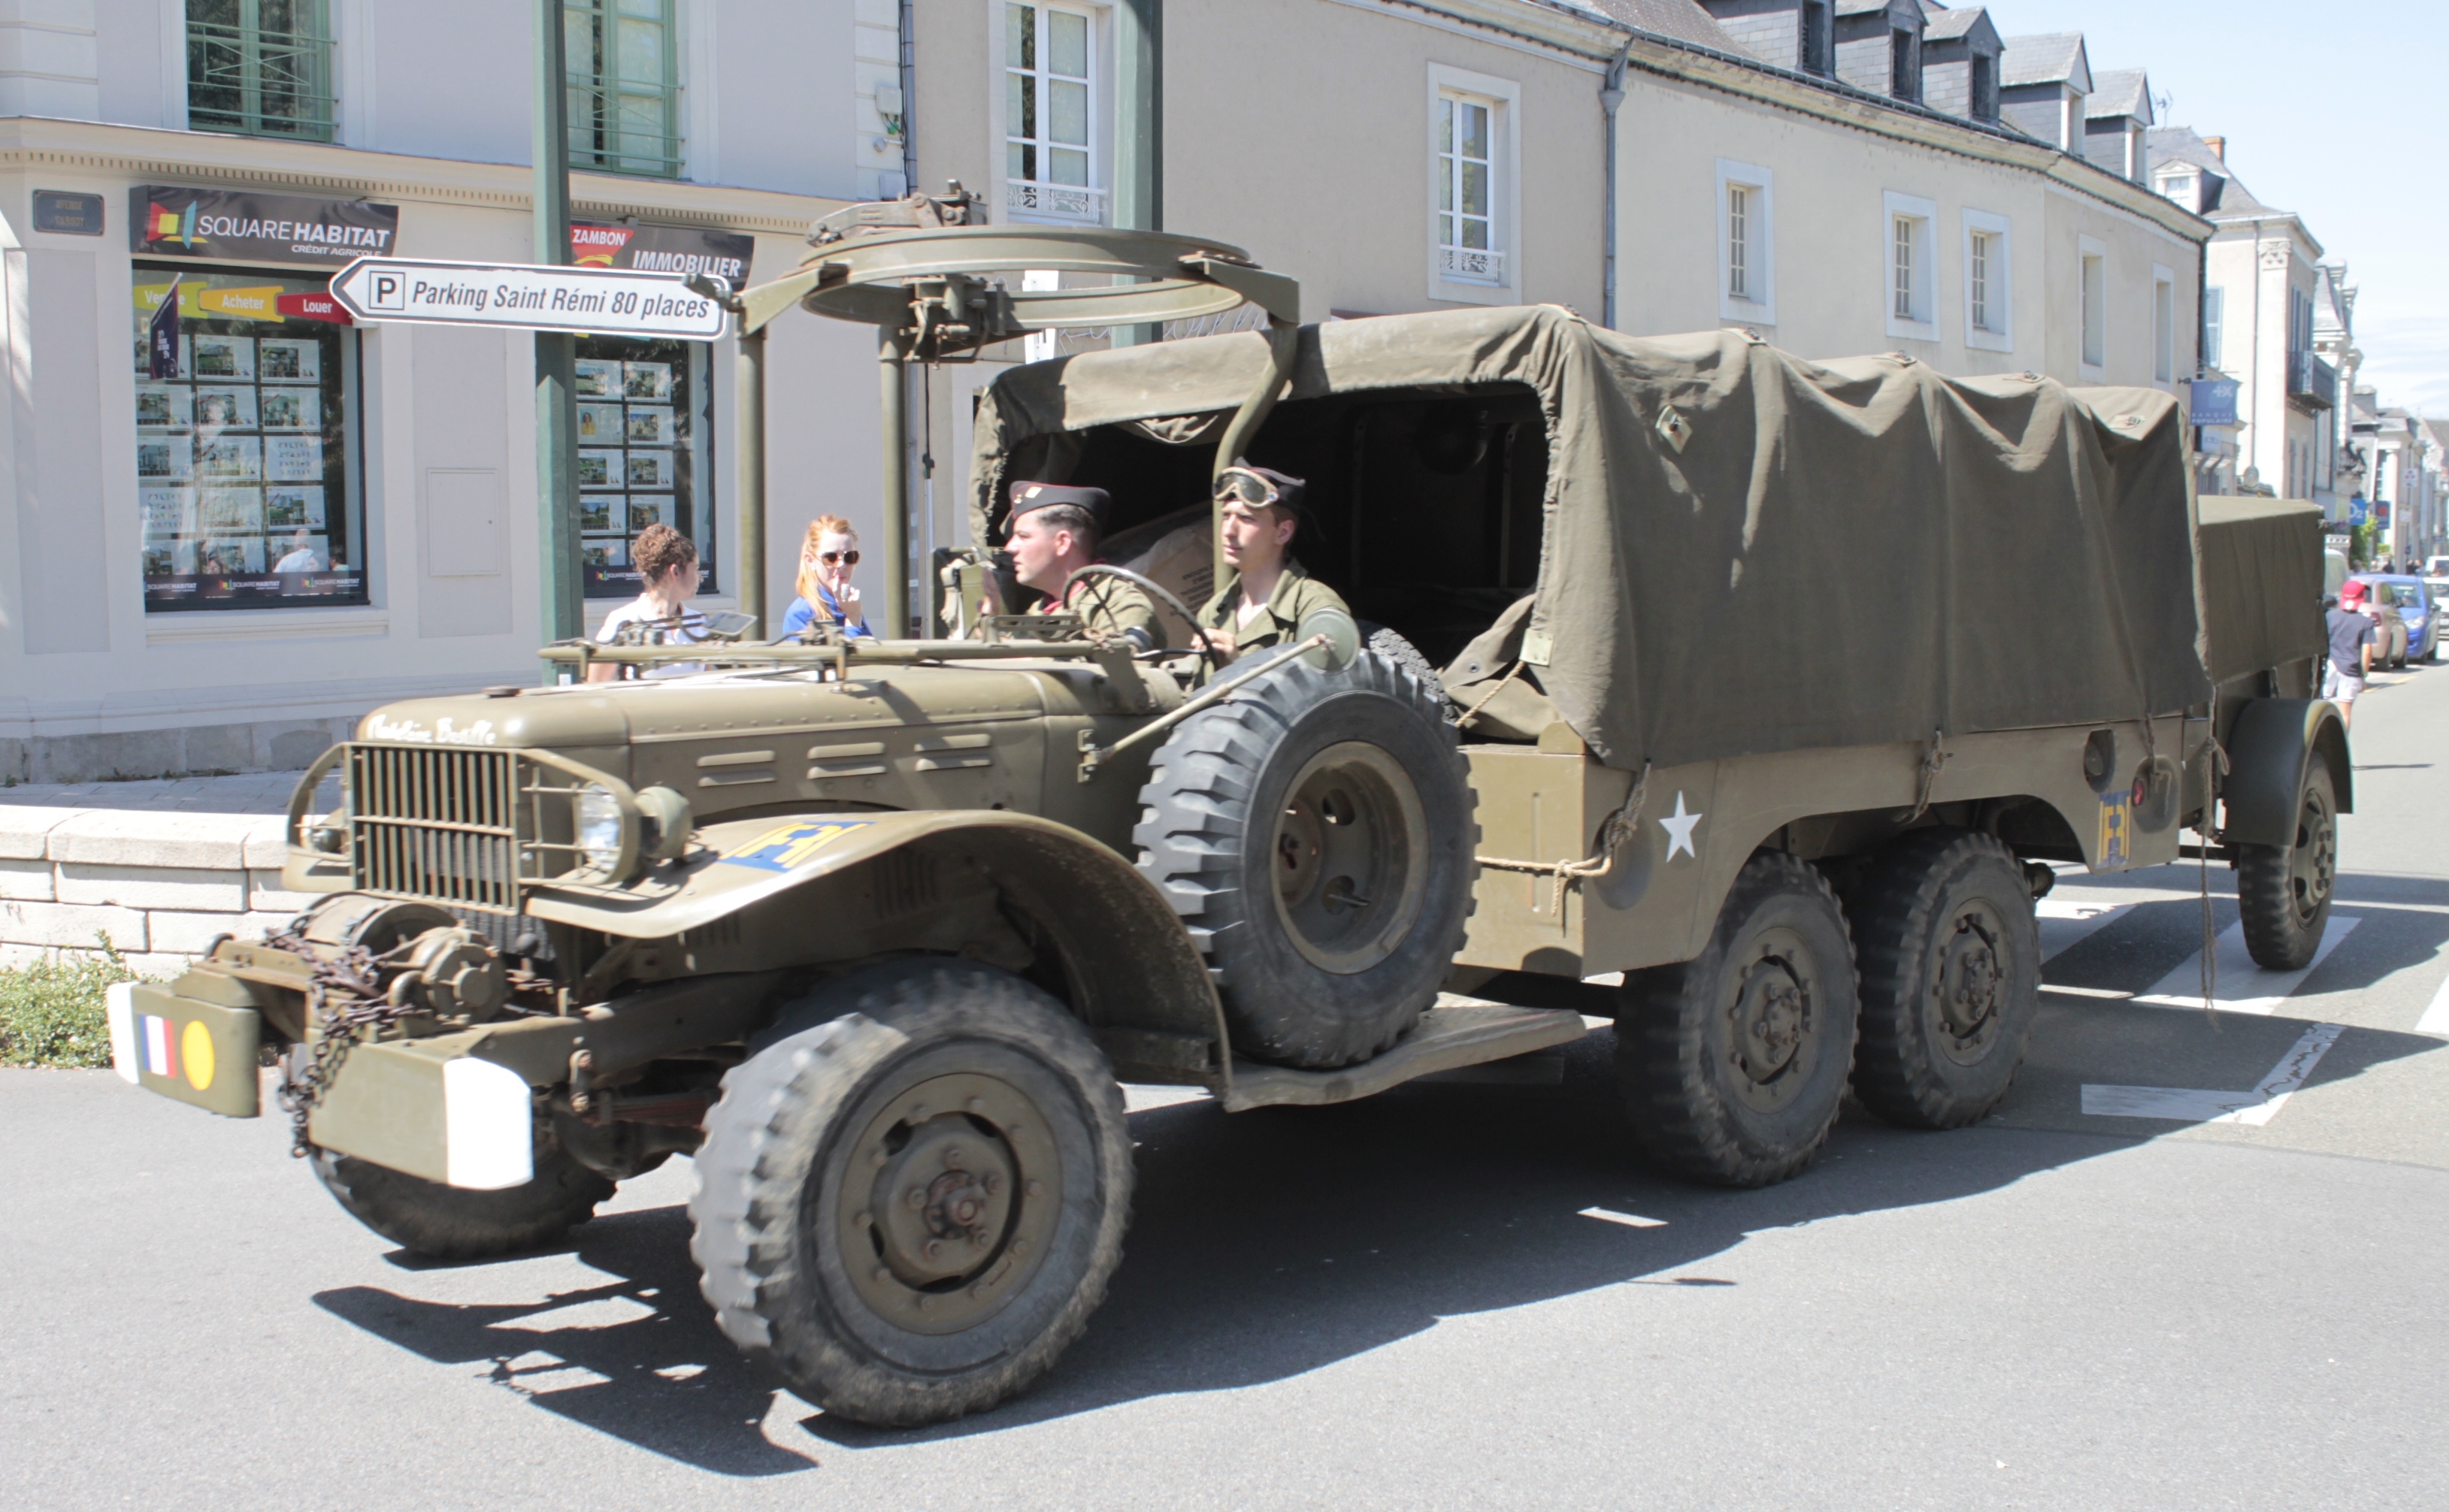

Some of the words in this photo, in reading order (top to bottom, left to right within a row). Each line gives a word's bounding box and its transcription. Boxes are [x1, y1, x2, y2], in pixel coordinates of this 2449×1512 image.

[198, 216, 292, 240] SQUARE
[293, 222, 390, 248] HABITAT
[572, 229, 626, 246] ZAMBON
[291, 243, 329, 255] CRÉDIT
[330, 246, 382, 256] AGRICOLE
[632, 250, 741, 277] IMMOBILIER
[222, 294, 265, 310] Acheter
[303, 298, 332, 313] Louer
[377, 277, 397, 304] P
[412, 281, 488, 311] Parking
[494, 285, 546, 309] Saint
[551, 288, 607, 313] Rémi
[611, 292, 638, 314] 80
[640, 293, 710, 320] places
